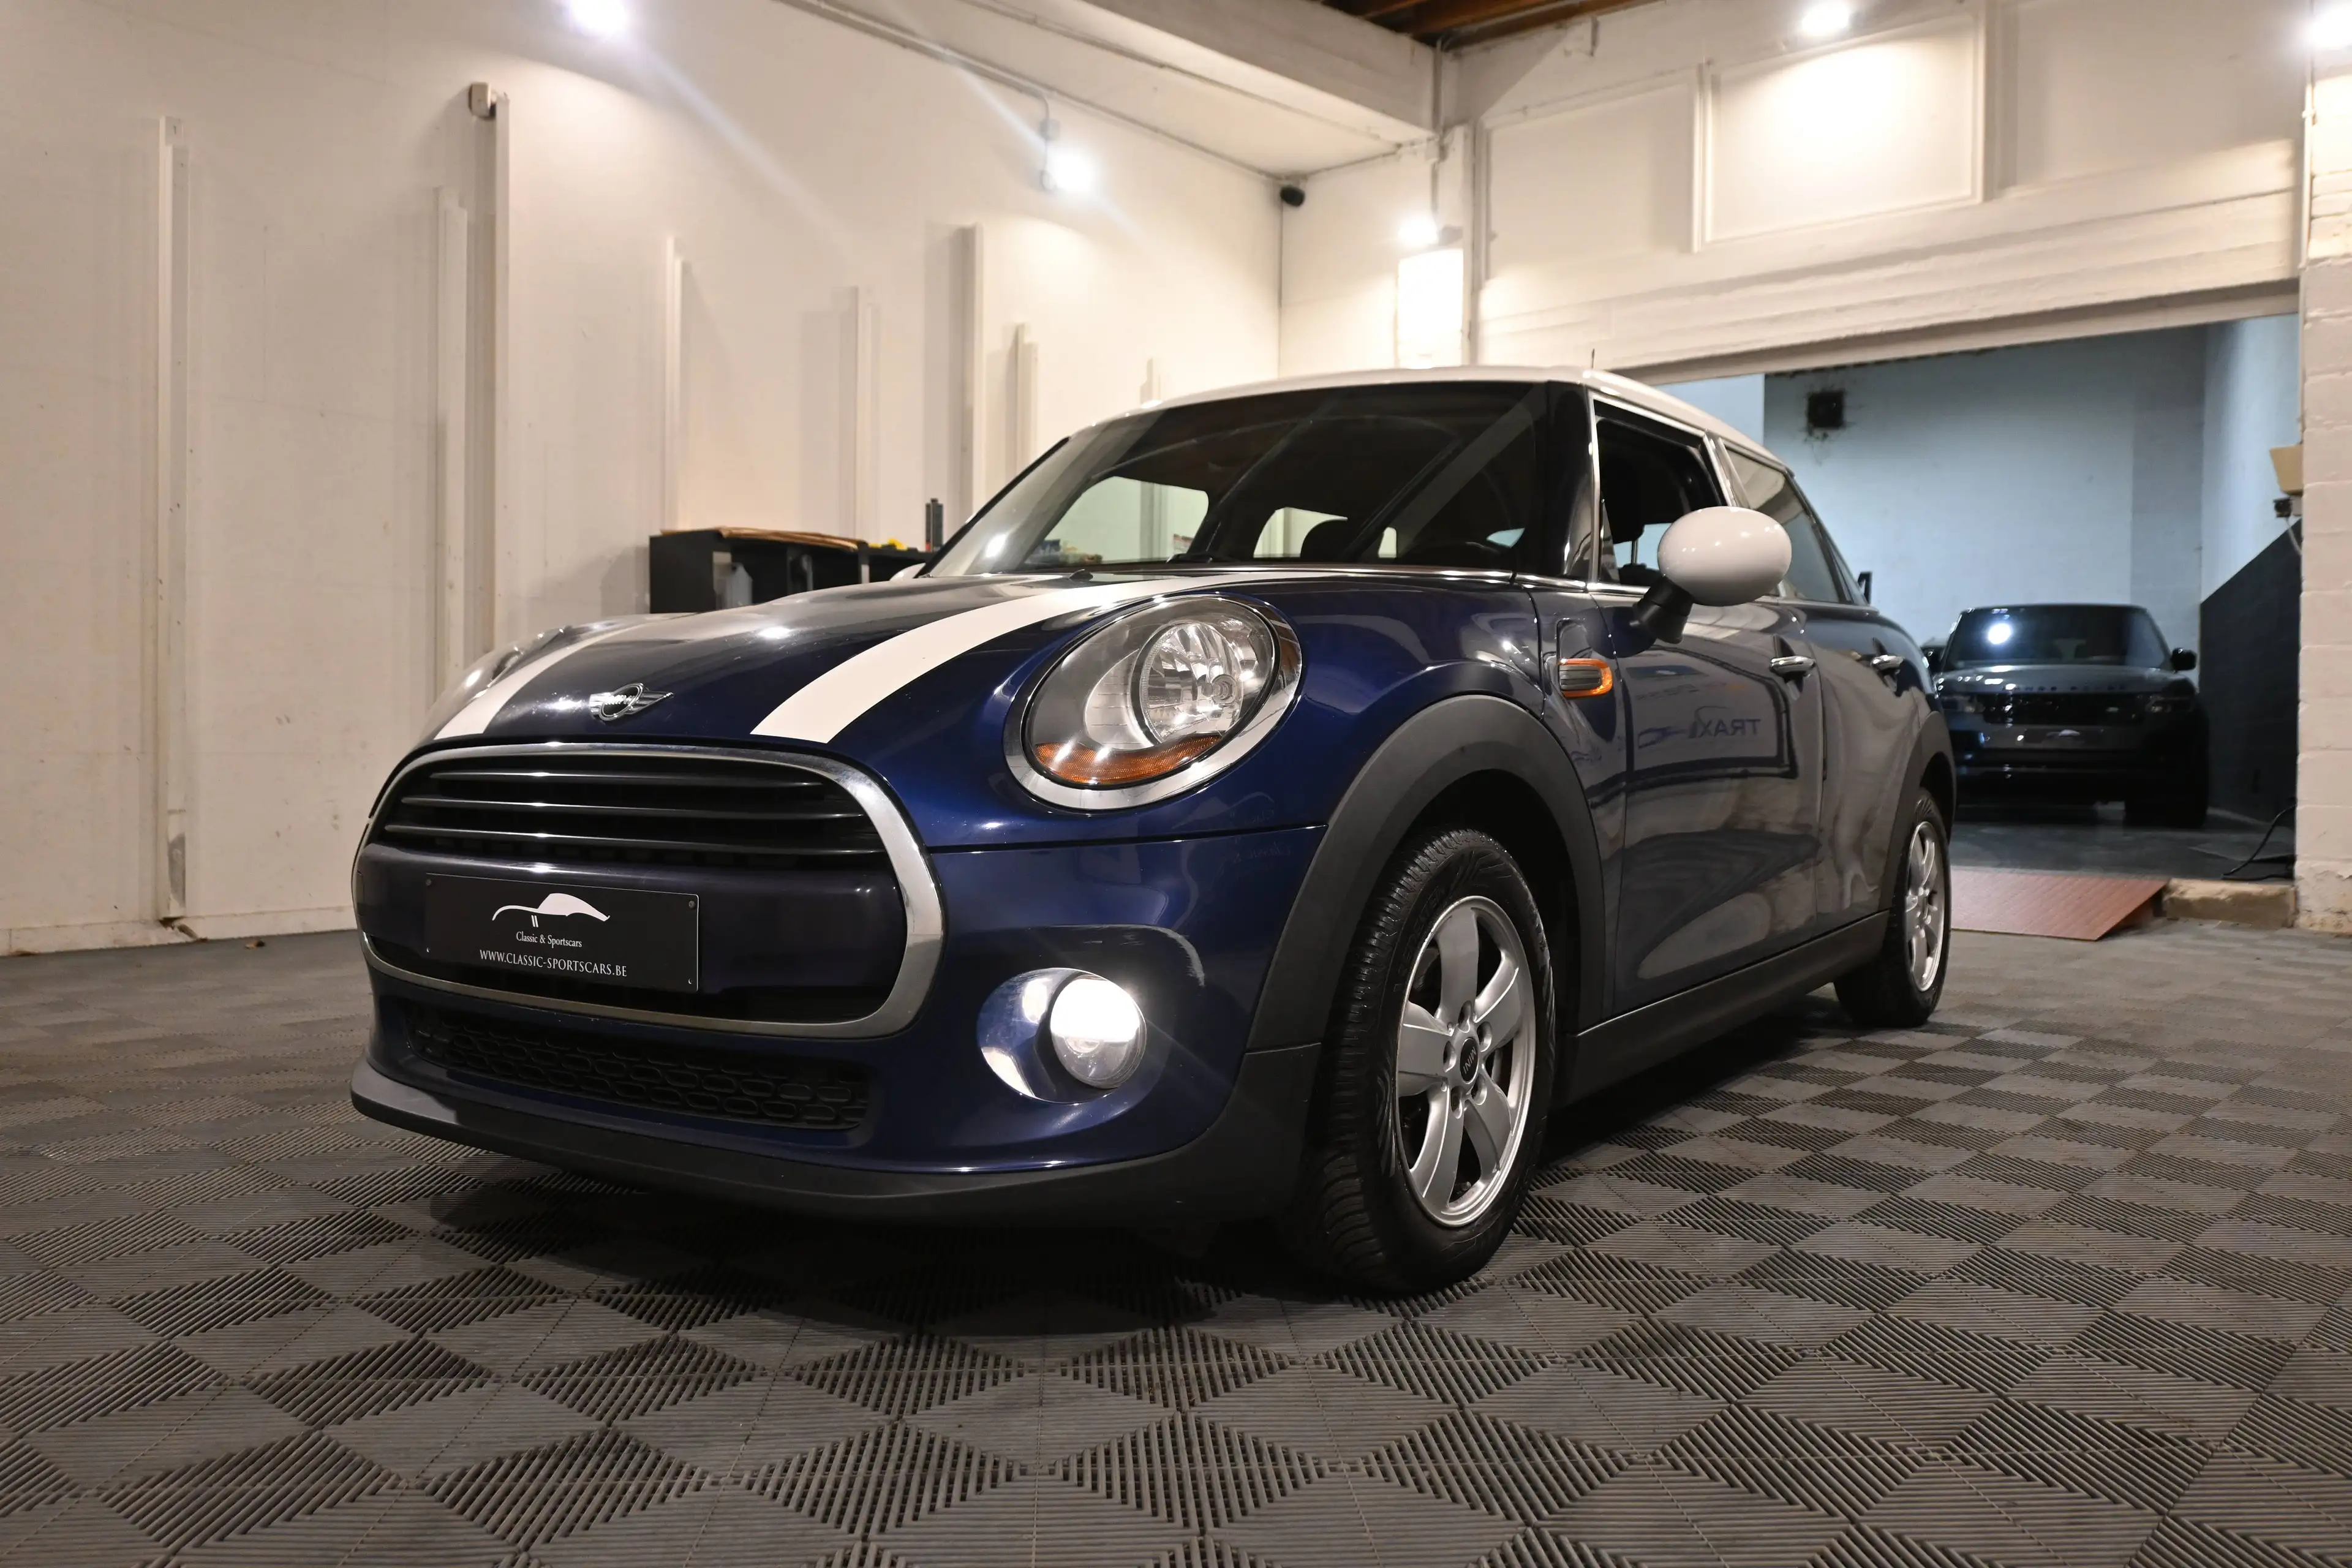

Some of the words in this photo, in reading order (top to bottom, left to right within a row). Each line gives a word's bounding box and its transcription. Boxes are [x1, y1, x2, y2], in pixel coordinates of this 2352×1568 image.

[516, 932, 538, 943] Classic
[540, 934, 546, 944] &
[548, 934, 582, 949] Sportscars
[480, 949, 627, 977] WWW.CLASSIC-SPORTSCARS.BE
[1463, 1046, 1477, 1074] MINI
